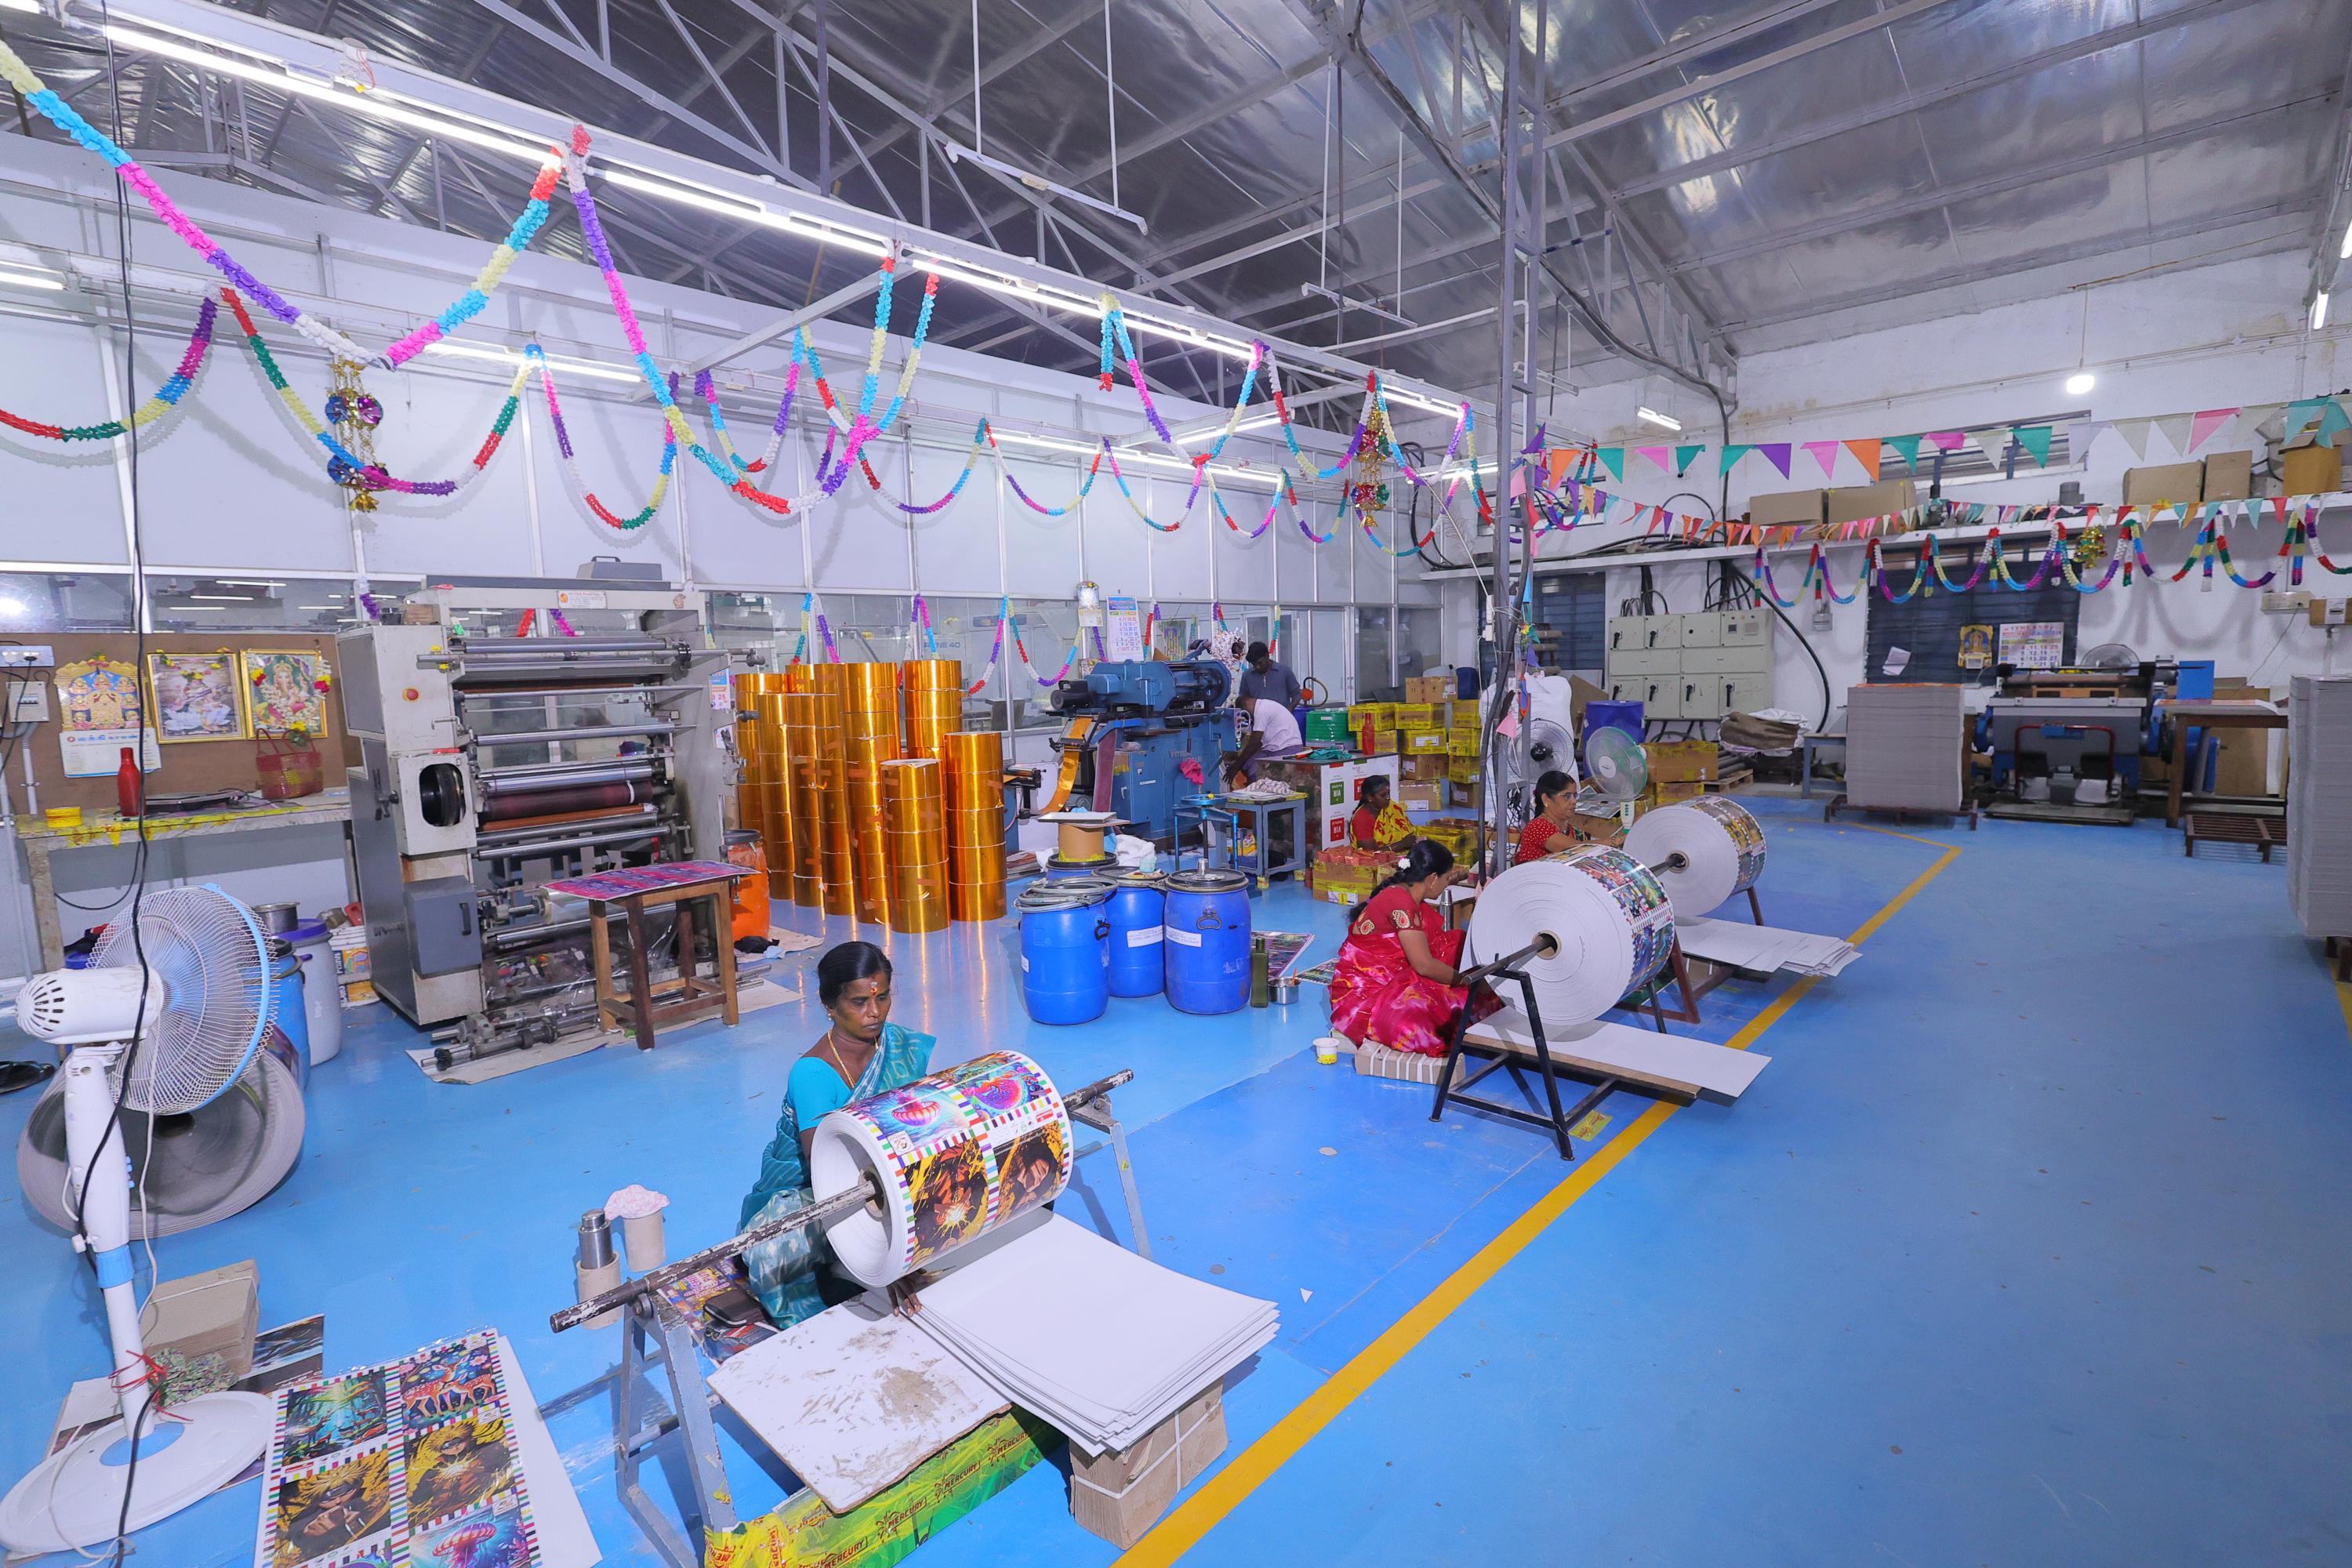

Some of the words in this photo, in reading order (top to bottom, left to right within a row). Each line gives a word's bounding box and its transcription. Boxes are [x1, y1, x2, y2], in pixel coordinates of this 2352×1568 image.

[944, 1462, 978, 1490] MERCURY
[887, 1498, 924, 1528] MERCURY
[824, 1539, 865, 1568] MERCURY
